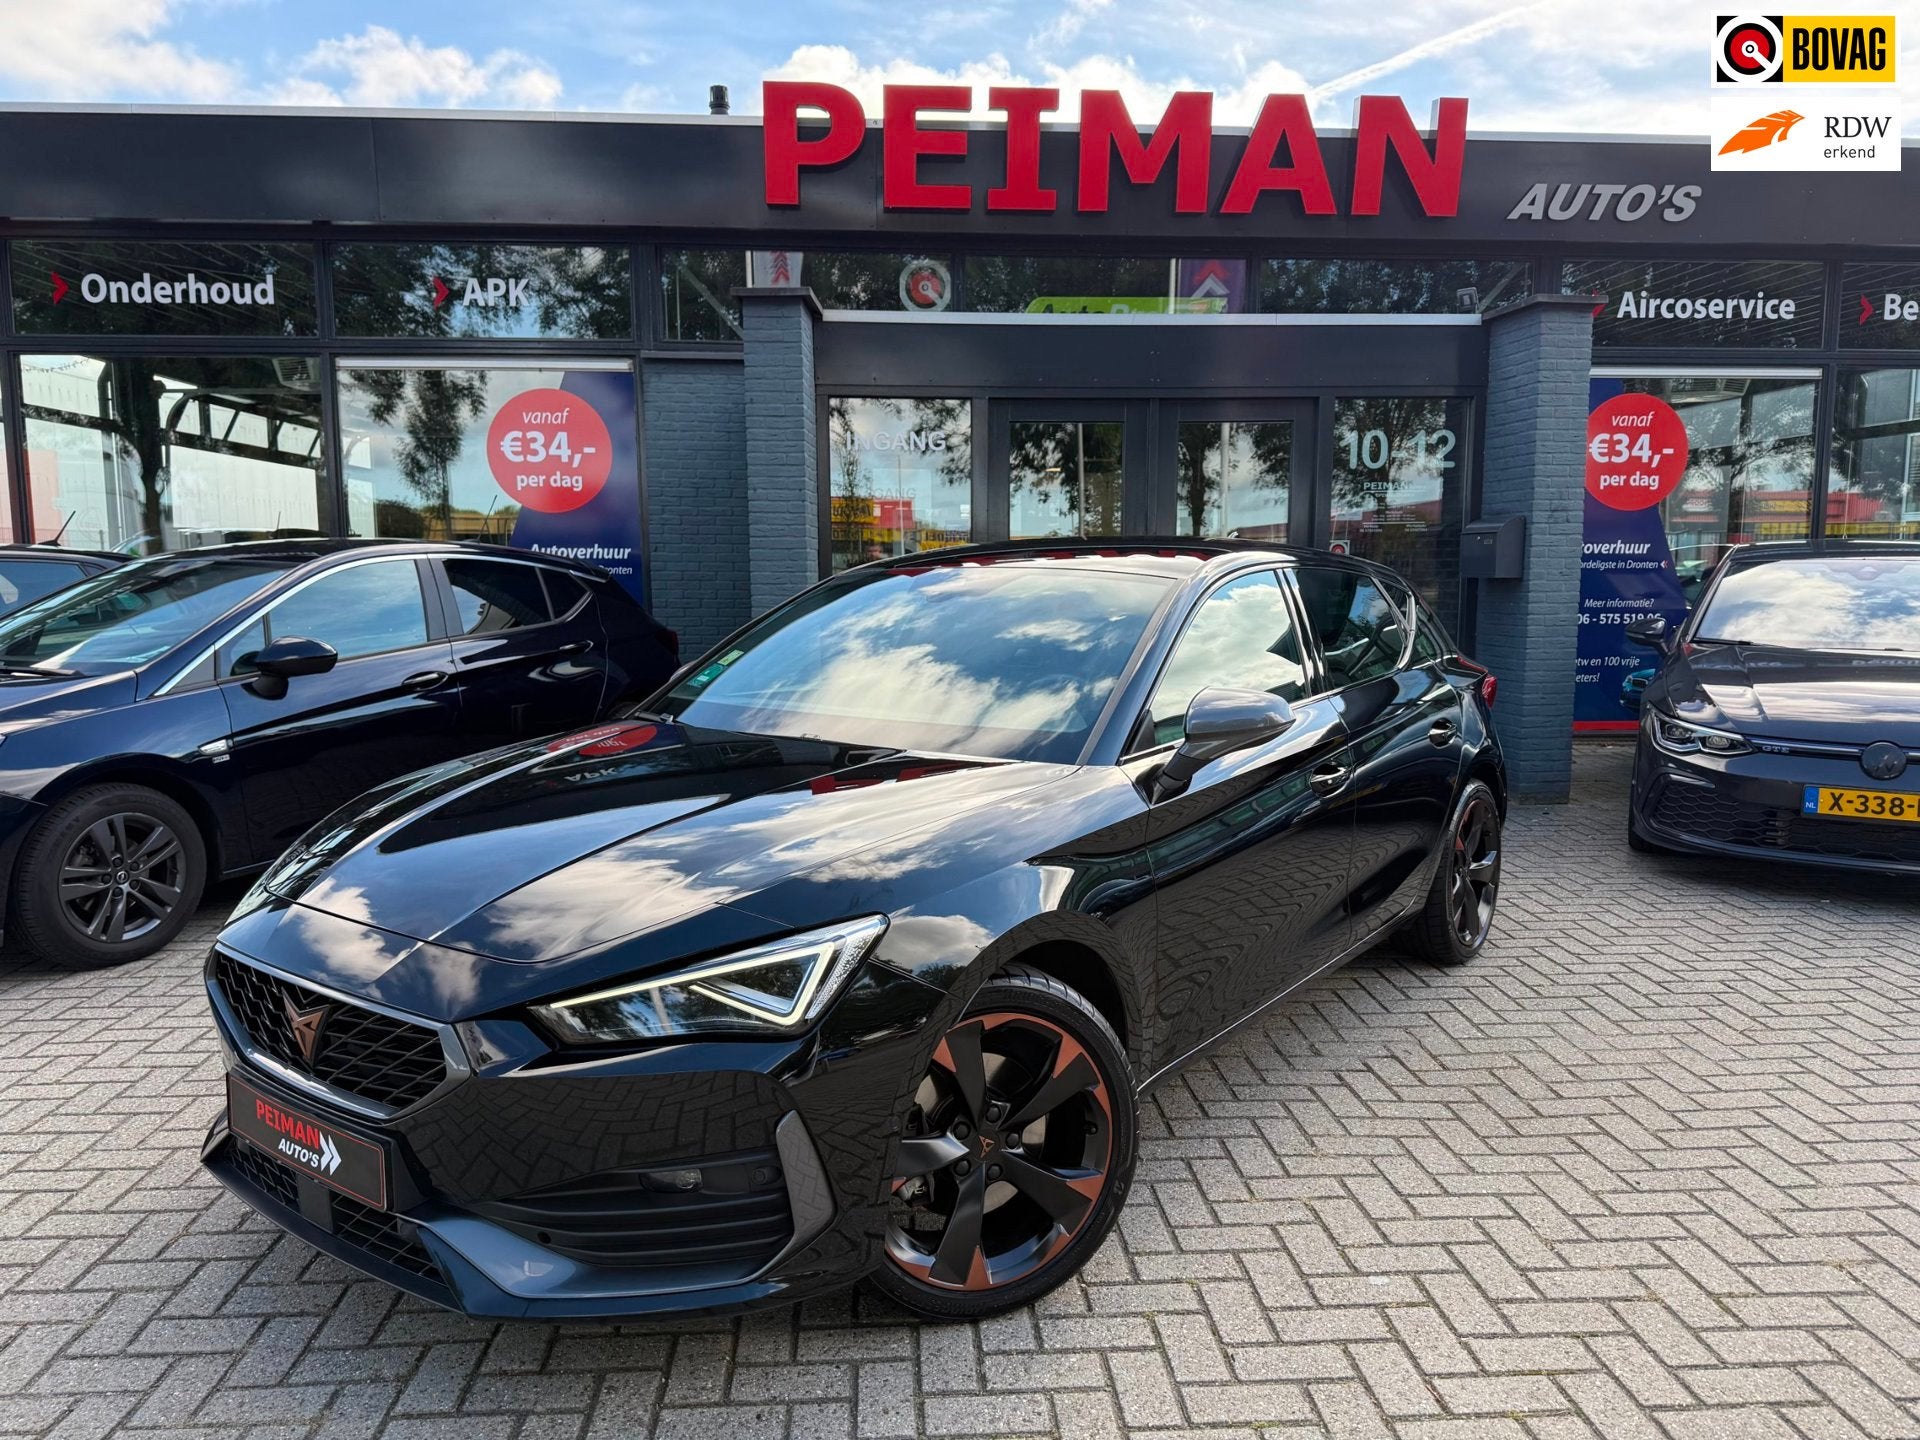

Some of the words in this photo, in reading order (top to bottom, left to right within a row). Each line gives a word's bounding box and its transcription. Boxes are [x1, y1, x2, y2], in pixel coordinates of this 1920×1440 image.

[762, 81, 1469, 218] PEIMAN
[1506, 183, 1702, 223] AUTO'S
[81, 272, 275, 305] Onderhoud
[462, 277, 530, 307] APK
[1616, 290, 1796, 320] Aircoservice
[522, 407, 570, 424] vanaf
[1611, 411, 1655, 427] vanaf
[500, 430, 596, 468] €34,-
[846, 430, 946, 451] INGANG
[1588, 433, 1675, 468] €34,-
[516, 474, 546, 490] per
[549, 470, 583, 491] dag
[1599, 474, 1626, 490] per
[1629, 470, 1660, 490] dag
[1582, 540, 1651, 554] overhuur
[1617, 560, 1625, 569] in
[1626, 560, 1659, 569] Dronten
[1584, 599, 1606, 608] Meer
[1606, 598, 1655, 608] informatie?
[1599, 613, 1621, 625] 575
[1604, 657, 1620, 666] 100
[1621, 657, 1640, 668] vrije
[1762, 745, 1790, 754] GTE
[1829, 792, 1920, 817] X-338-
[255, 1098, 319, 1149] PEIMAN
[278, 1138, 320, 1168] AUTO'S
